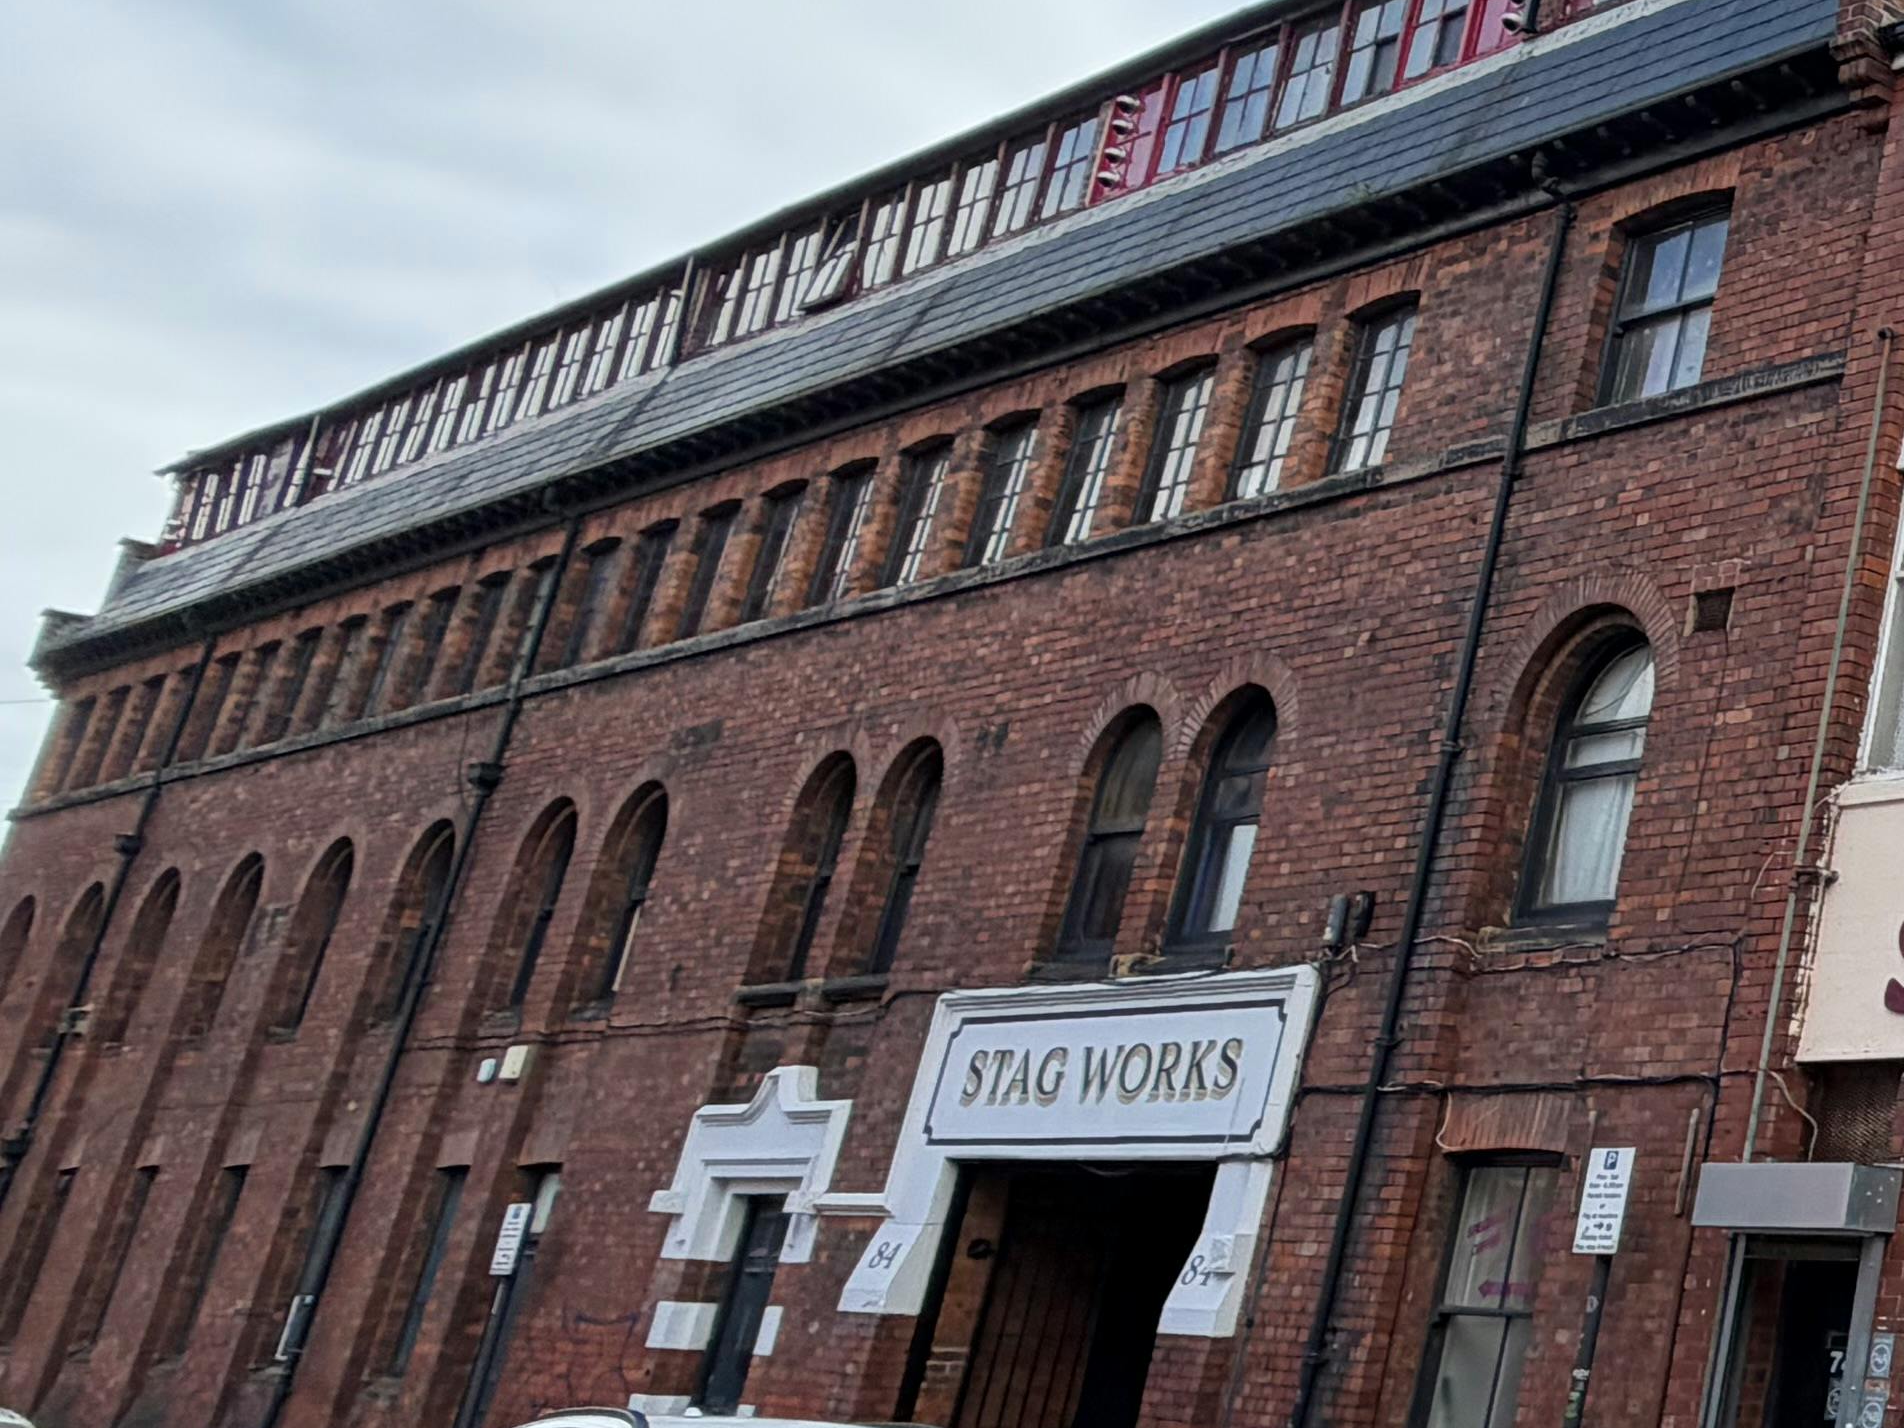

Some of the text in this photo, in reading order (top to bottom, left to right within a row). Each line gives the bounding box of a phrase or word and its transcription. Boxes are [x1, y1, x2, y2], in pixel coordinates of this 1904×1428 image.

[960, 1038, 1243, 1107] STAG WORKS
[868, 1241, 903, 1269] 84
